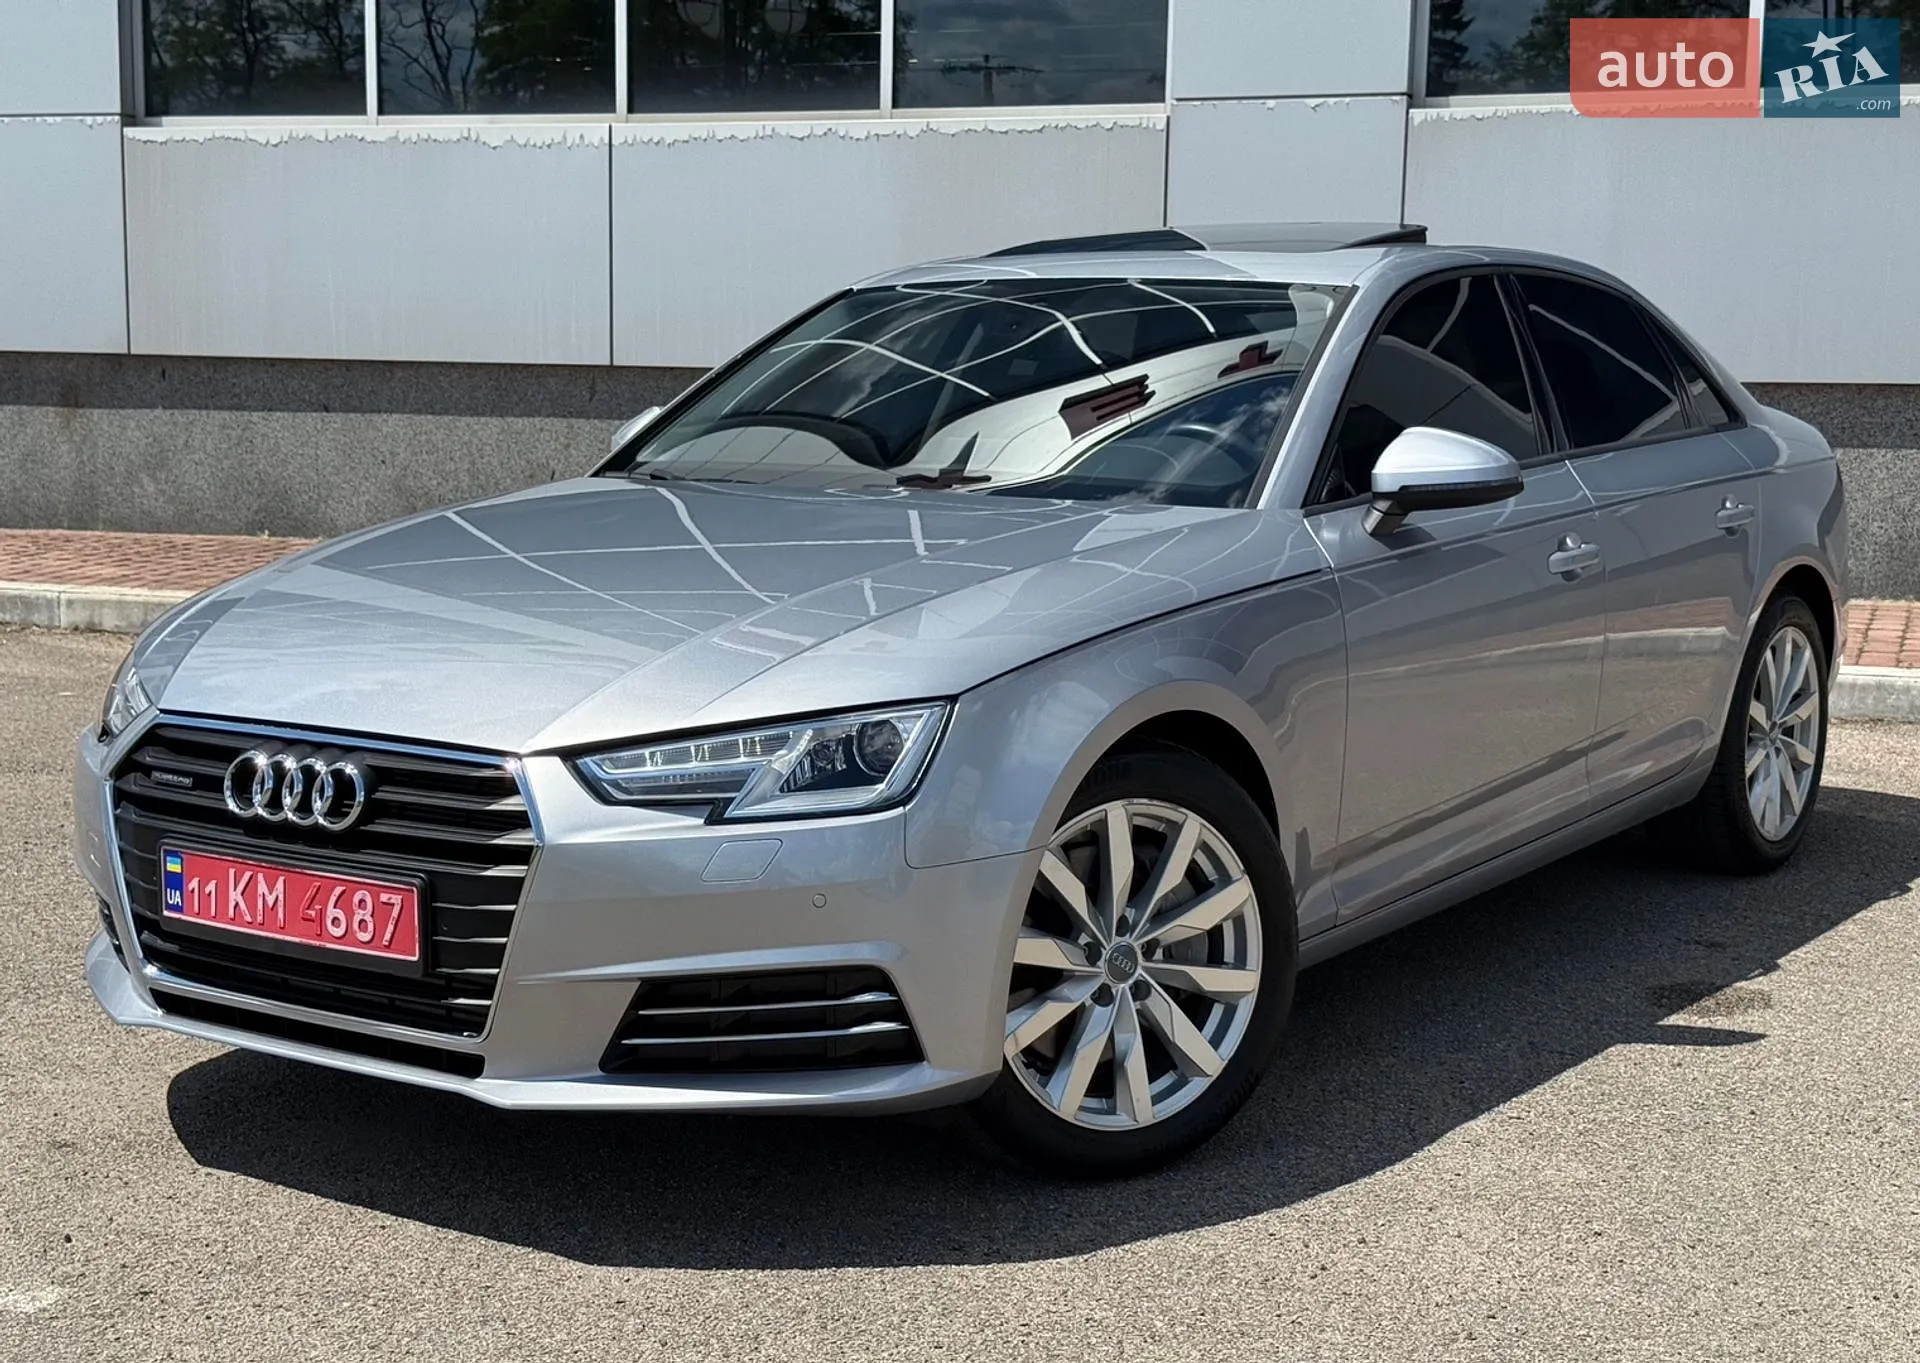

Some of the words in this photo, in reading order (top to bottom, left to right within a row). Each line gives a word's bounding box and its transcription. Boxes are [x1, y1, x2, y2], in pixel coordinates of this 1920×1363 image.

[166, 887, 182, 907] UA
[187, 877, 218, 918] 11
[228, 868, 287, 929] KM
[301, 882, 403, 947] 4687
